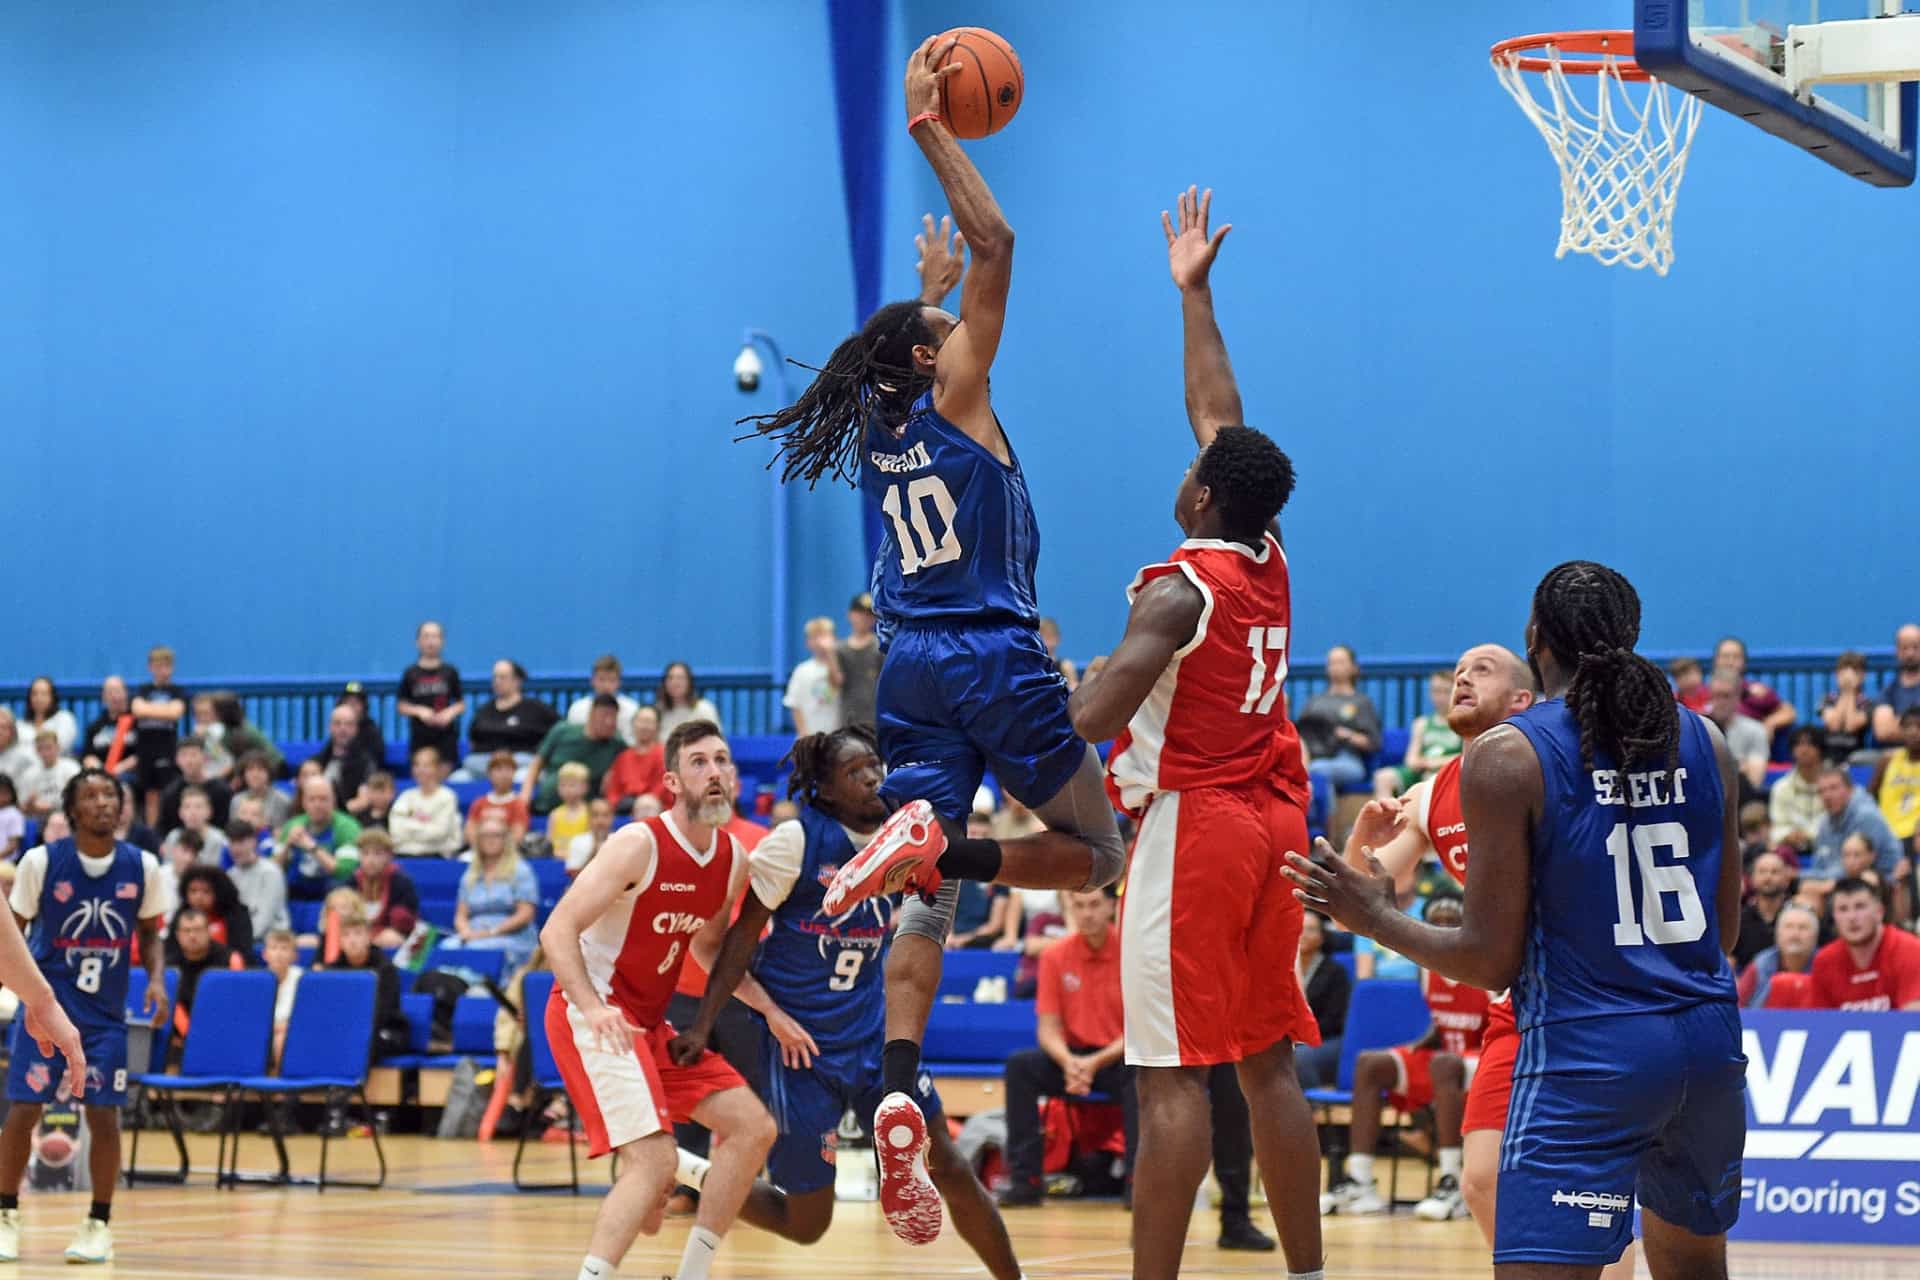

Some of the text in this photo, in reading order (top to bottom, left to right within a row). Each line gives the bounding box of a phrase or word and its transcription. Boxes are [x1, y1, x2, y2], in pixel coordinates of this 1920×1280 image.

[882, 475, 962, 576] 10
[1239, 626, 1288, 714] 17
[1606, 822, 1707, 946] 16
[76, 957, 103, 994] 8
[657, 940, 680, 975] 8
[829, 949, 865, 991] 9
[113, 1068, 128, 1092] 8
